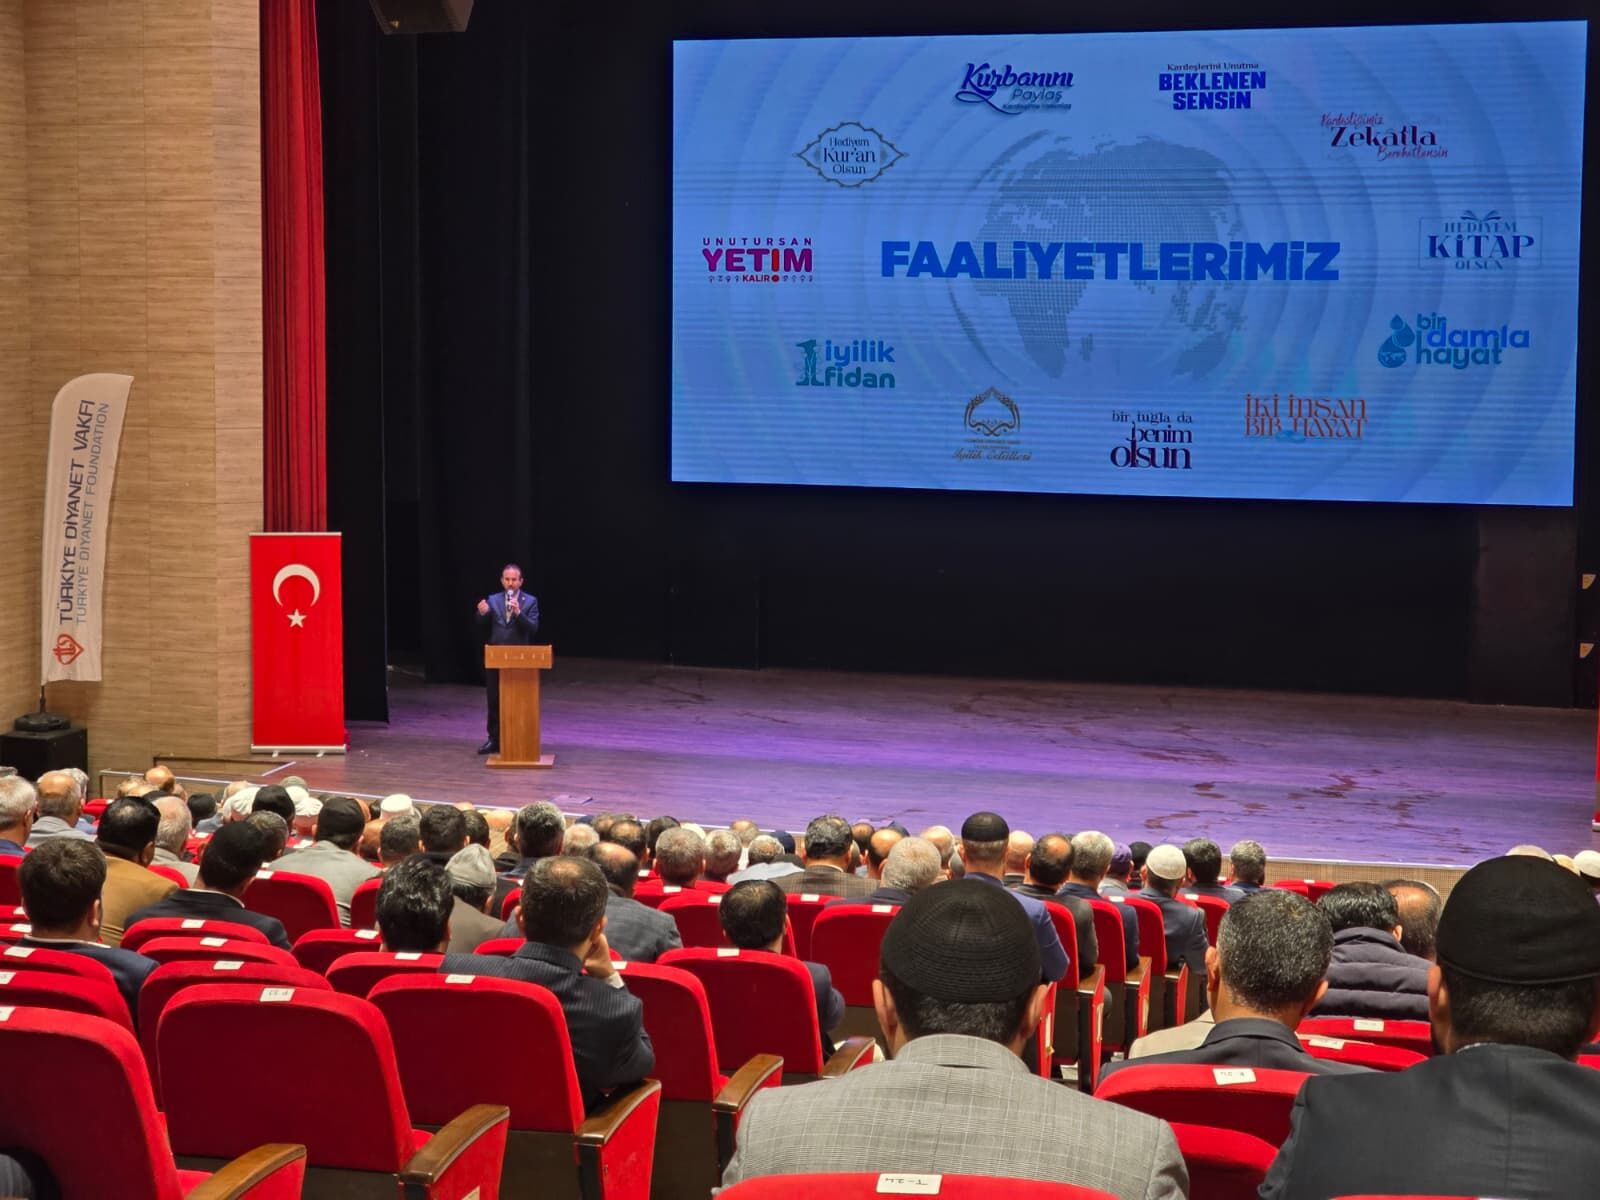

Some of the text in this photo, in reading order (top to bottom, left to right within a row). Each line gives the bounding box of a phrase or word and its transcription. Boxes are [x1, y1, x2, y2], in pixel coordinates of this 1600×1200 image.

[957, 62, 1075, 98] Kurbanını
[1159, 71, 1266, 90] BEKLENEN
[1011, 88, 1063, 102] Paylaş
[823, 147, 876, 163] Kur'an
[832, 163, 866, 175] Olsun
[703, 237, 813, 246] UNUTURSAN
[1416, 312, 1447, 330] bir
[1426, 321, 1530, 348] damla
[825, 339, 896, 367] iyilik
[1416, 330, 1503, 370] hayat
[824, 366, 896, 388] fidan
[1112, 410, 1130, 422] bir
[1177, 411, 1193, 424] da
[85, 402, 110, 497] FOUNDATION
[57, 399, 96, 625] TÜRKİYE DİYANET VAKFI
